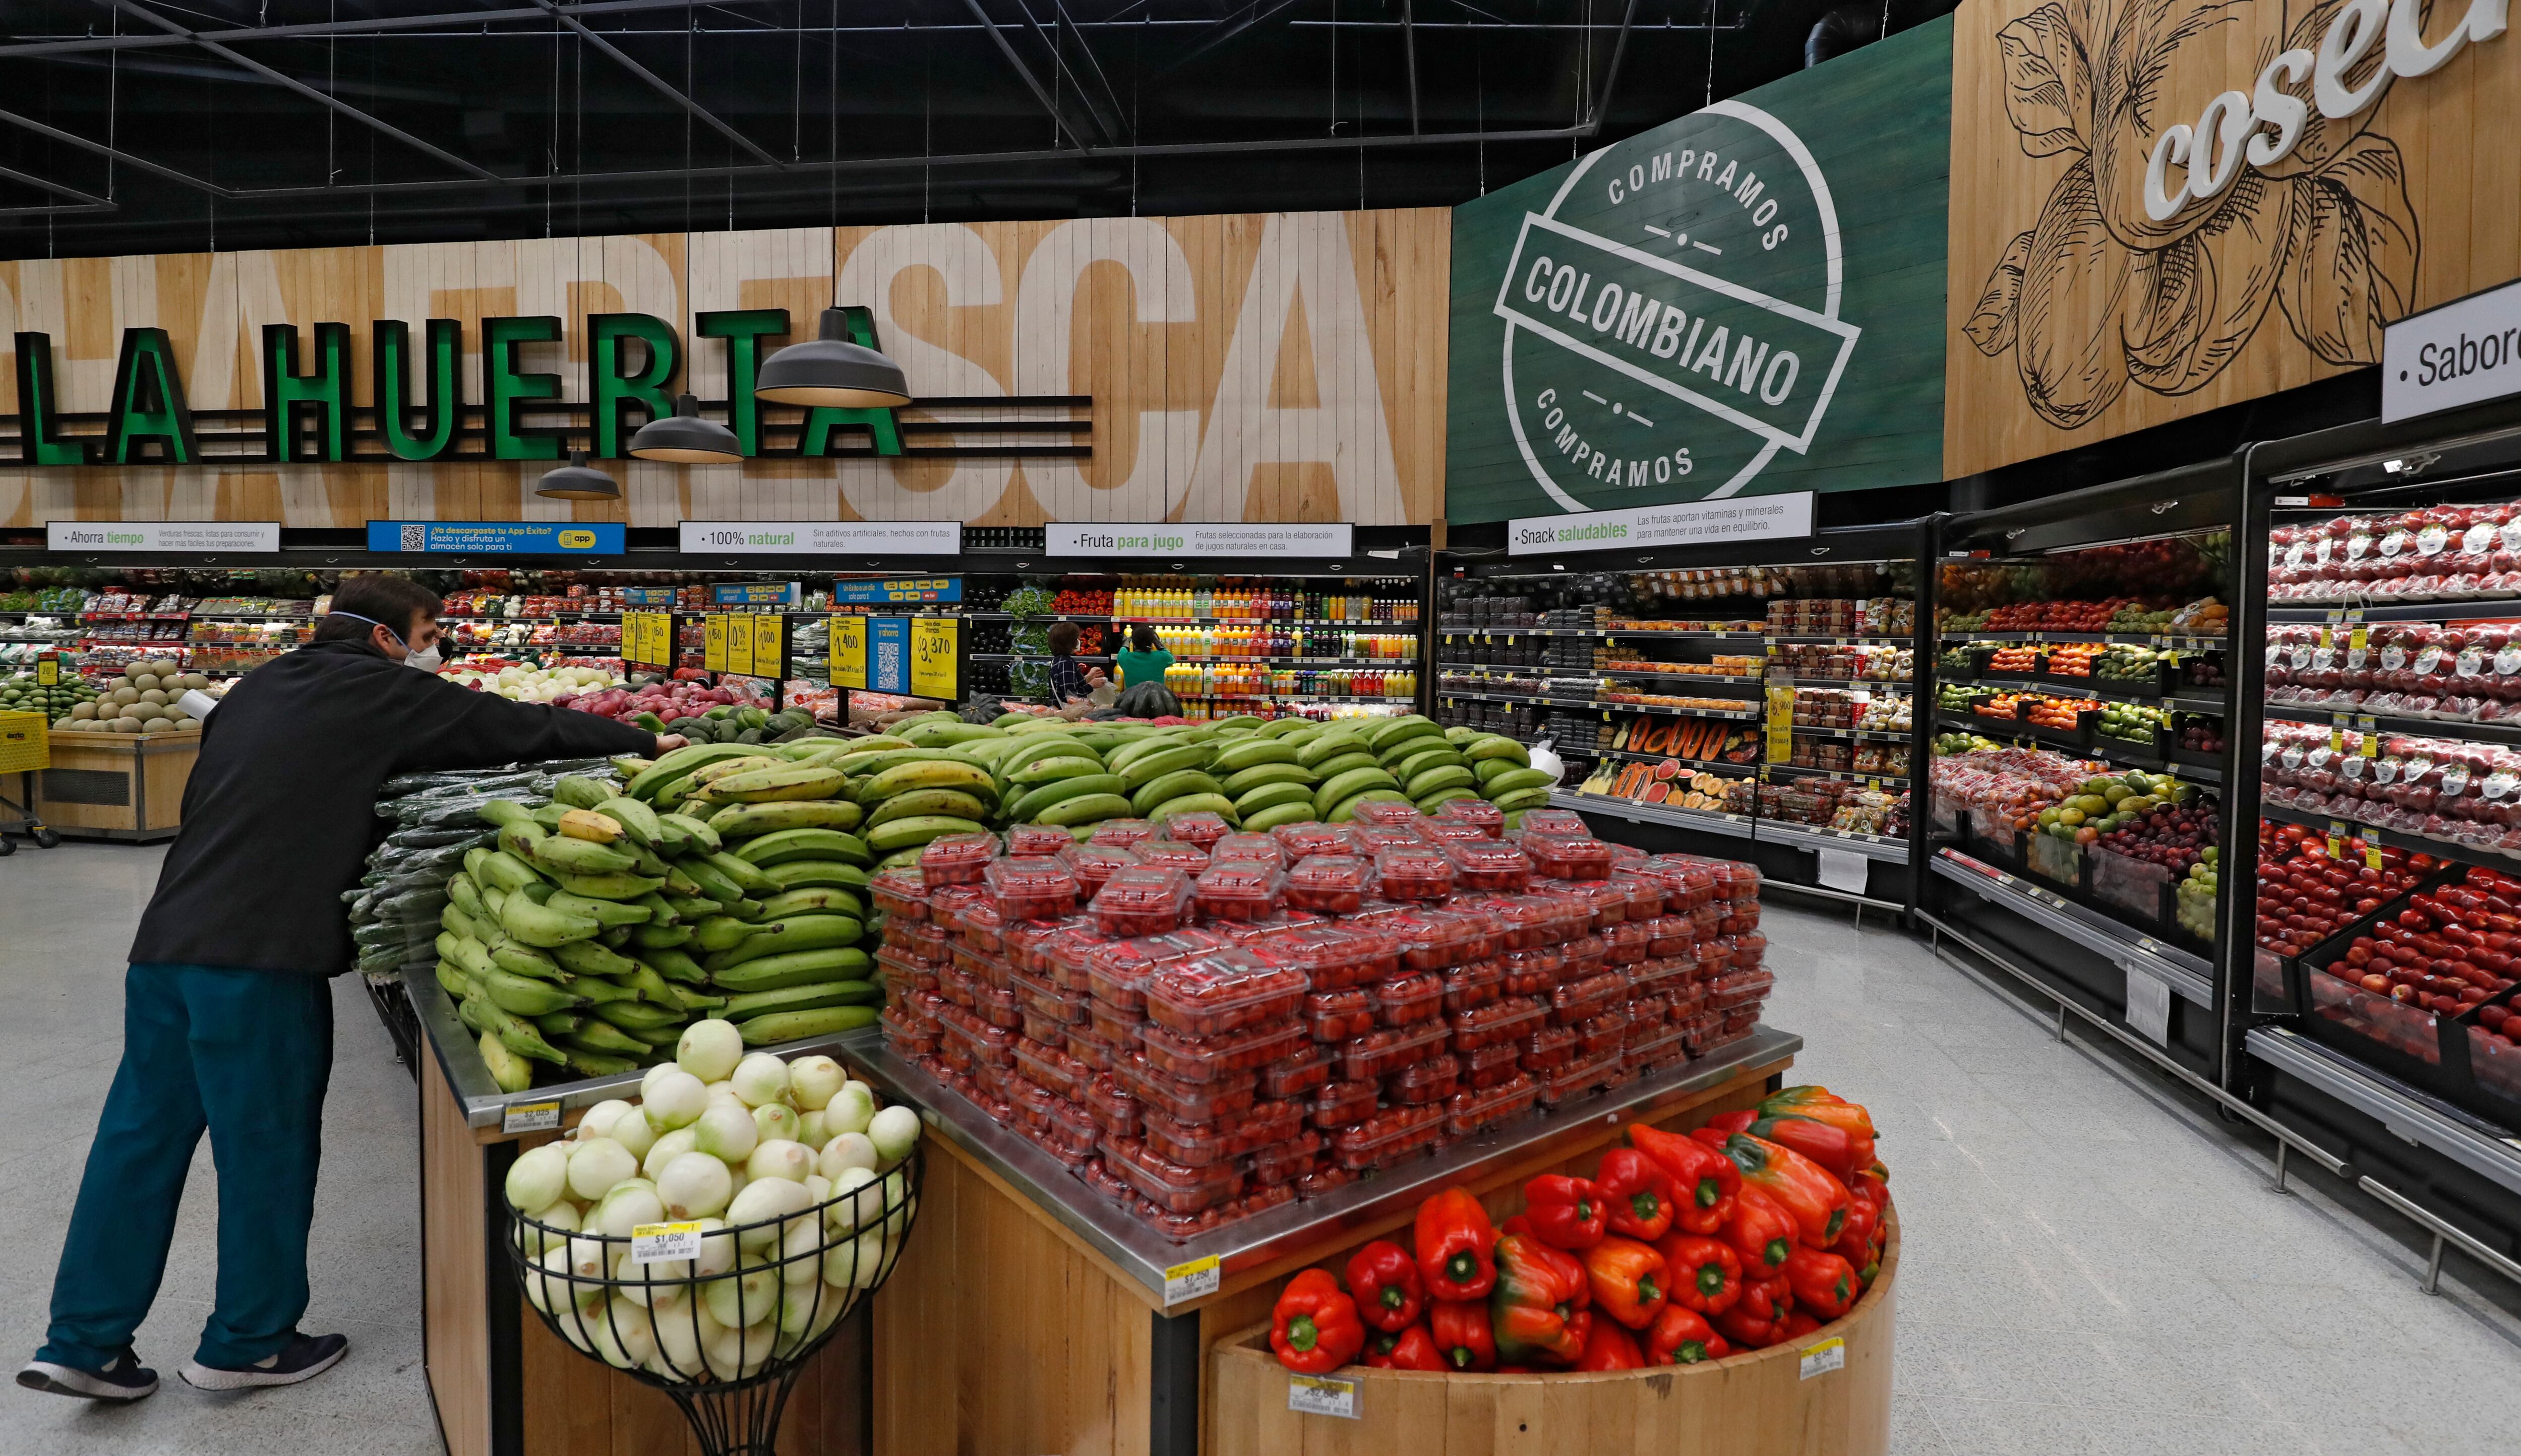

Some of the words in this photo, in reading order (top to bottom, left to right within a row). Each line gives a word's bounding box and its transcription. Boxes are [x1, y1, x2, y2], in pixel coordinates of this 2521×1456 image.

[1608, 149, 1788, 251] COMPRAMOS
[1525, 256, 1800, 406] COLOMBIANO
[2418, 325, 2521, 387] Sabor
[14, 327, 201, 465] LA
[262, 305, 905, 463] HUERTA
[1537, 388, 1694, 487] COMPRAMOS
[1638, 516, 1649, 525] Las
[1651, 514, 1671, 524] frutas
[1673, 512, 1700, 523] aportan
[1702, 509, 1736, 520] vitaminas
[1738, 510, 1743, 518] y
[1746, 505, 1784, 517] minerales
[70, 531, 104, 543] Ahorra
[107, 531, 144, 546] tiempo
[446, 527, 496, 536] descargaste
[526, 526, 552, 535] Éxito?
[709, 531, 745, 545] 100%
[748, 531, 795, 545] natural
[852, 529, 888, 538] artificiales,
[930, 529, 950, 537] frutas
[1195, 531, 1217, 539] Frutas
[1218, 531, 1266, 539] seleccionadas
[1268, 532, 1284, 540] para
[1285, 531, 1291, 539] la
[1293, 531, 1333, 539] elaboración
[1521, 527, 1555, 544] Snack
[1558, 521, 1628, 542] saludables
[1637, 530, 1652, 540] para
[1654, 528, 1687, 538] mantener
[1689, 526, 1702, 535] una
[1704, 524, 1719, 534] vida
[1733, 520, 1770, 533] equilibrio.
[1080, 533, 1114, 548] Fruta
[1117, 535, 1149, 552] para
[1152, 533, 1184, 552] jugo
[1195, 542, 1204, 550] de
[1205, 542, 1224, 552] jugos
[1226, 542, 1257, 550] naturales
[882, 628, 899, 637] ahorra
[918, 635, 950, 663] $3.370
[655, 1233, 685, 1243] $1,050
